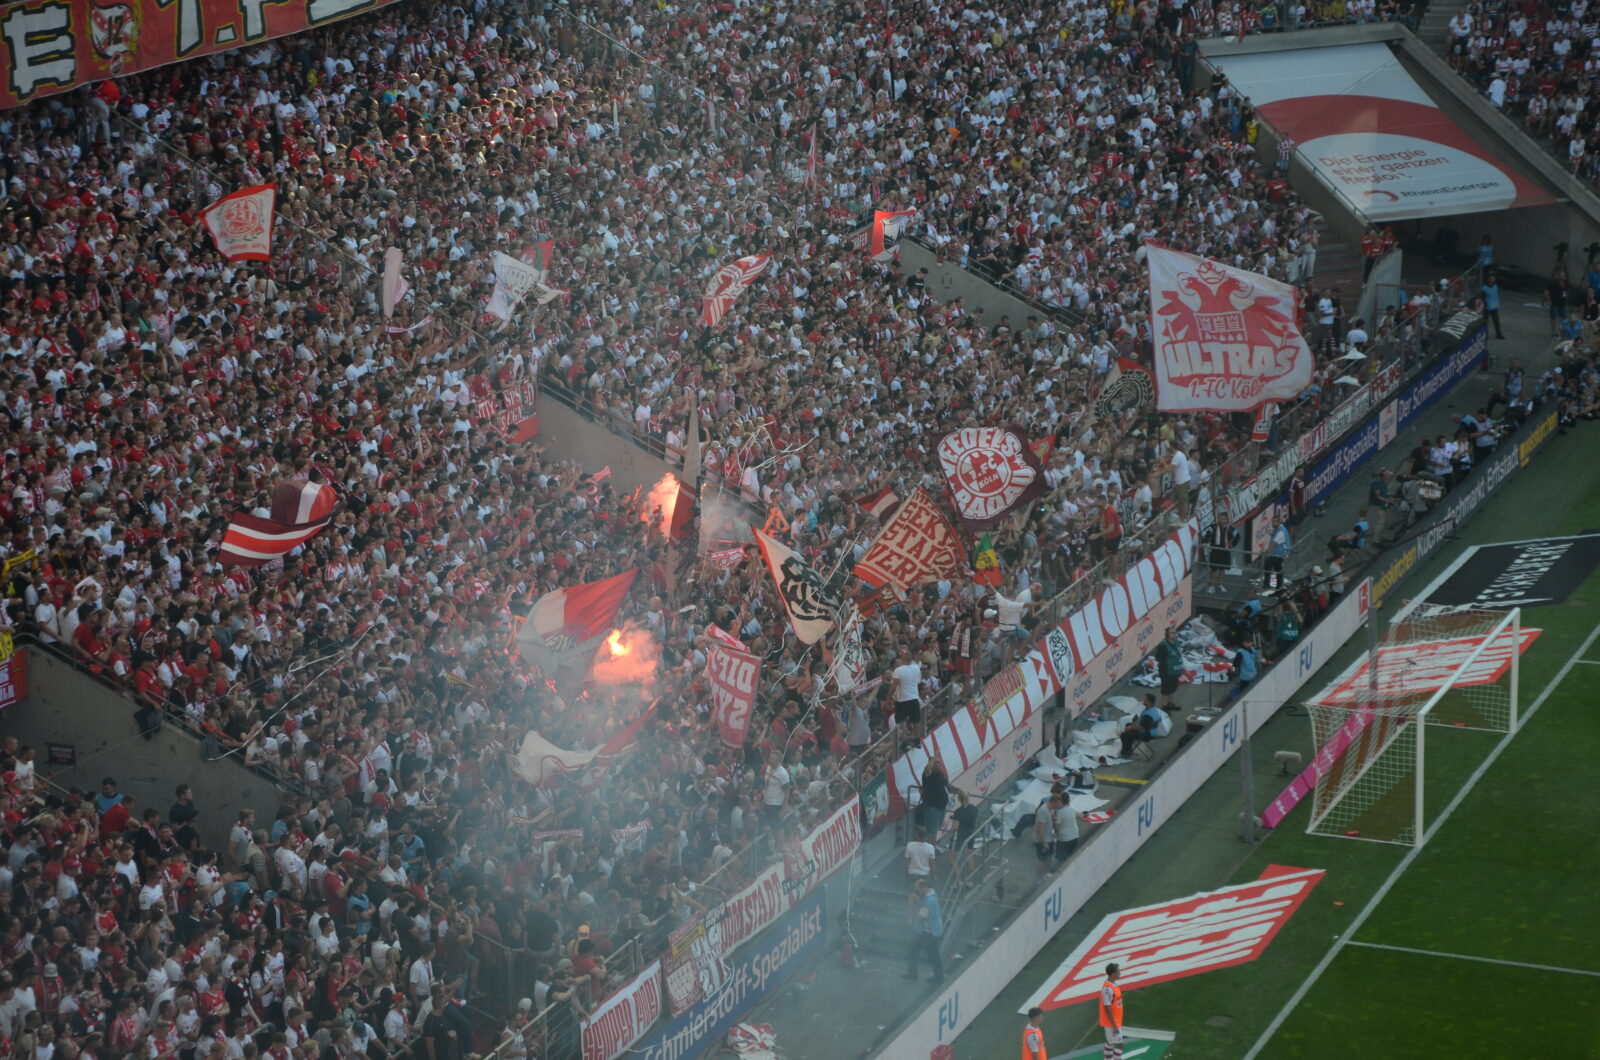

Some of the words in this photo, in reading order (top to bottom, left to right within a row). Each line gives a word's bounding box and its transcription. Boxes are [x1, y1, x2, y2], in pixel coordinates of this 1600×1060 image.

[1319, 155, 1352, 168] Die
[1353, 148, 1428, 164] Energie
[1332, 164, 1376, 177] einer
[1381, 156, 1450, 173] ganzen
[1401, 181, 1500, 197] RheinEnergie
[1163, 341, 1299, 378] ULTRAS
[1191, 378, 1200, 398] 1.
[1204, 377, 1226, 399] FC
[1399, 398, 1413, 422] Der
[937, 427, 1022, 480] VEEDELS
[978, 473, 1000, 488] KÖLN
[1072, 677, 1092, 699] FUCHS
[1012, 727, 1032, 754] FUCHS
[975, 761, 996, 785] FUCHS
